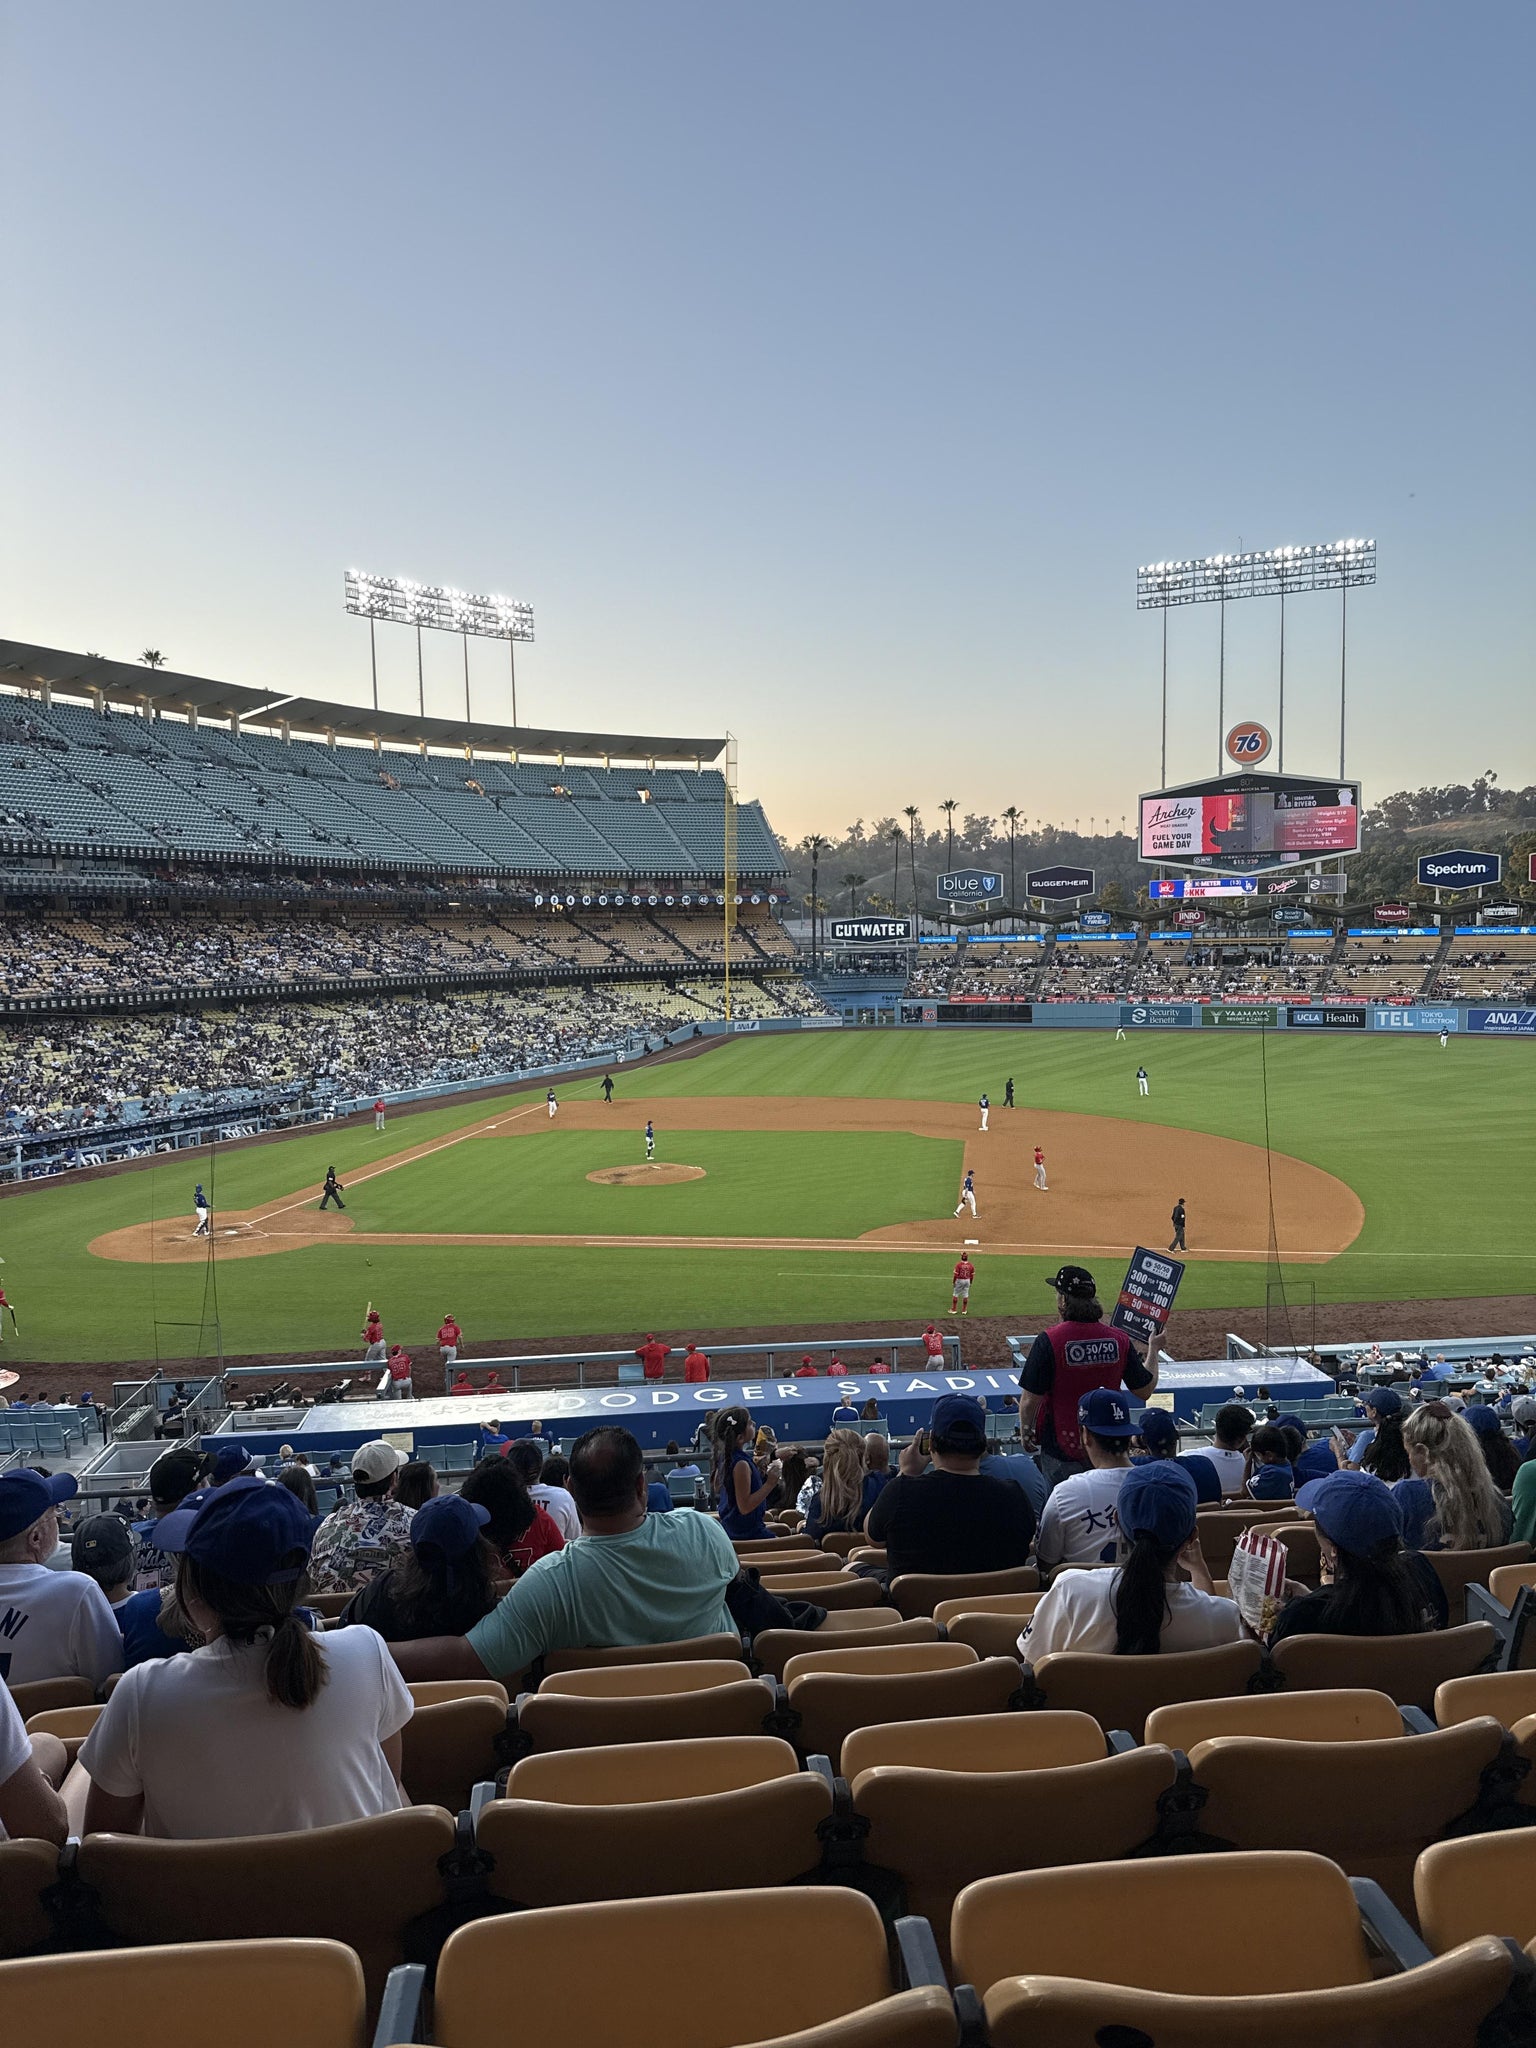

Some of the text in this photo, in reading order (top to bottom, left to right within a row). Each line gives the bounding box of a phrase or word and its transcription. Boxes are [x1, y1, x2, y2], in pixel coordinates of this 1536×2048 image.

[1234, 731, 1261, 753] 76
[1148, 803, 1196, 824] Archer
[1153, 841, 1174, 849] GAME
[1426, 863, 1486, 876] Spectrum
[943, 876, 978, 890] blue
[1268, 878, 1298, 894] Dodgers
[1179, 912, 1200, 921] JINRO
[836, 924, 905, 936] CUTWATER
[924, 1011, 936, 1019] 76
[1150, 1008, 1180, 1017] Security
[1326, 1014, 1359, 1022] Health
[1377, 1011, 1414, 1026] TEL
[1485, 1013, 1517, 1024] ANA
[1153, 1262, 1170, 1273] 50/50
[1130, 1270, 1148, 1284] 300
[1156, 1280, 1173, 1295] $150
[1128, 1283, 1142, 1297] 150
[1151, 1292, 1168, 1308] $100
[1131, 1298, 1142, 1310] 50
[1149, 1305, 1161, 1318] $50
[1124, 1310, 1133, 1322] 10
[1086, 1343, 1114, 1354] 50/50
[558, 1384, 803, 1411] DODGER
[1110, 1402, 1124, 1420] LA
